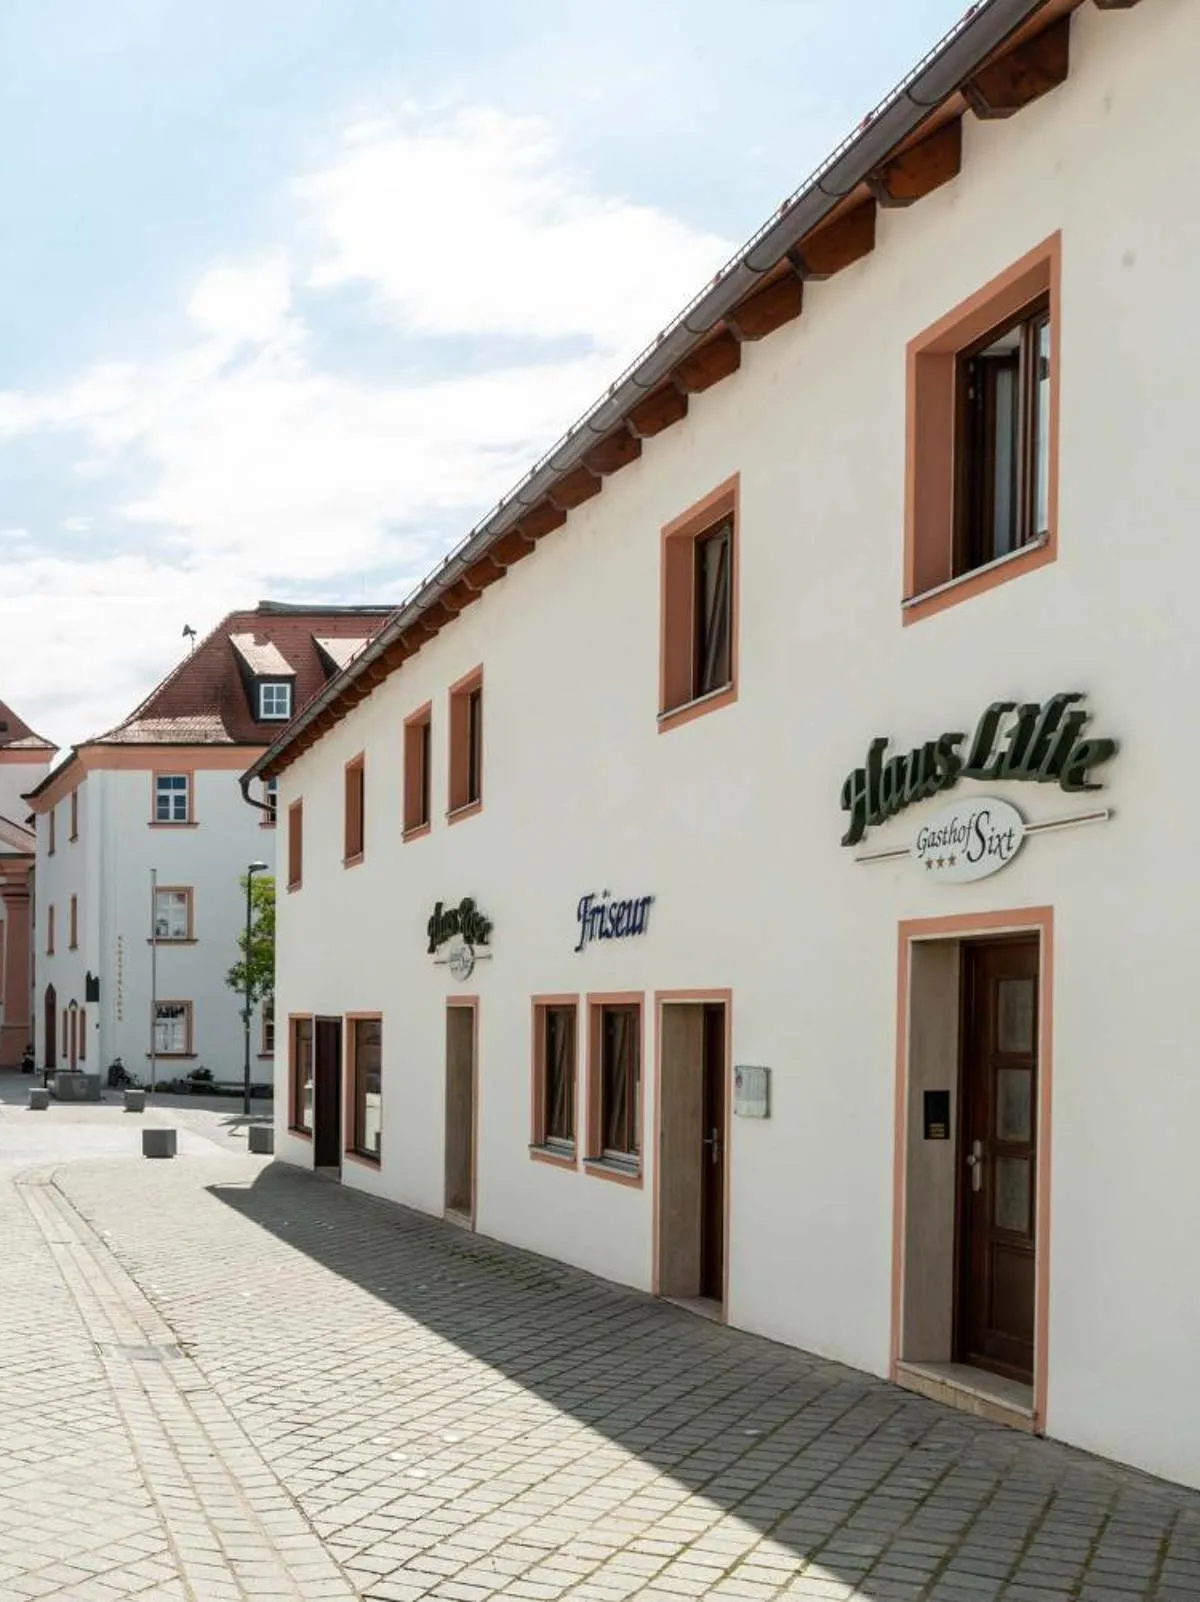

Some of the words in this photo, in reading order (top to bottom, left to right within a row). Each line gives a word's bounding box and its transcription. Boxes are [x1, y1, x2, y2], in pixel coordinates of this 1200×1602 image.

[840, 732, 965, 846] Haus
[957, 692, 1119, 792] Lilie
[916, 813, 975, 858] Gasthof
[966, 811, 1015, 863] Sixt
[574, 890, 655, 952] Friseur
